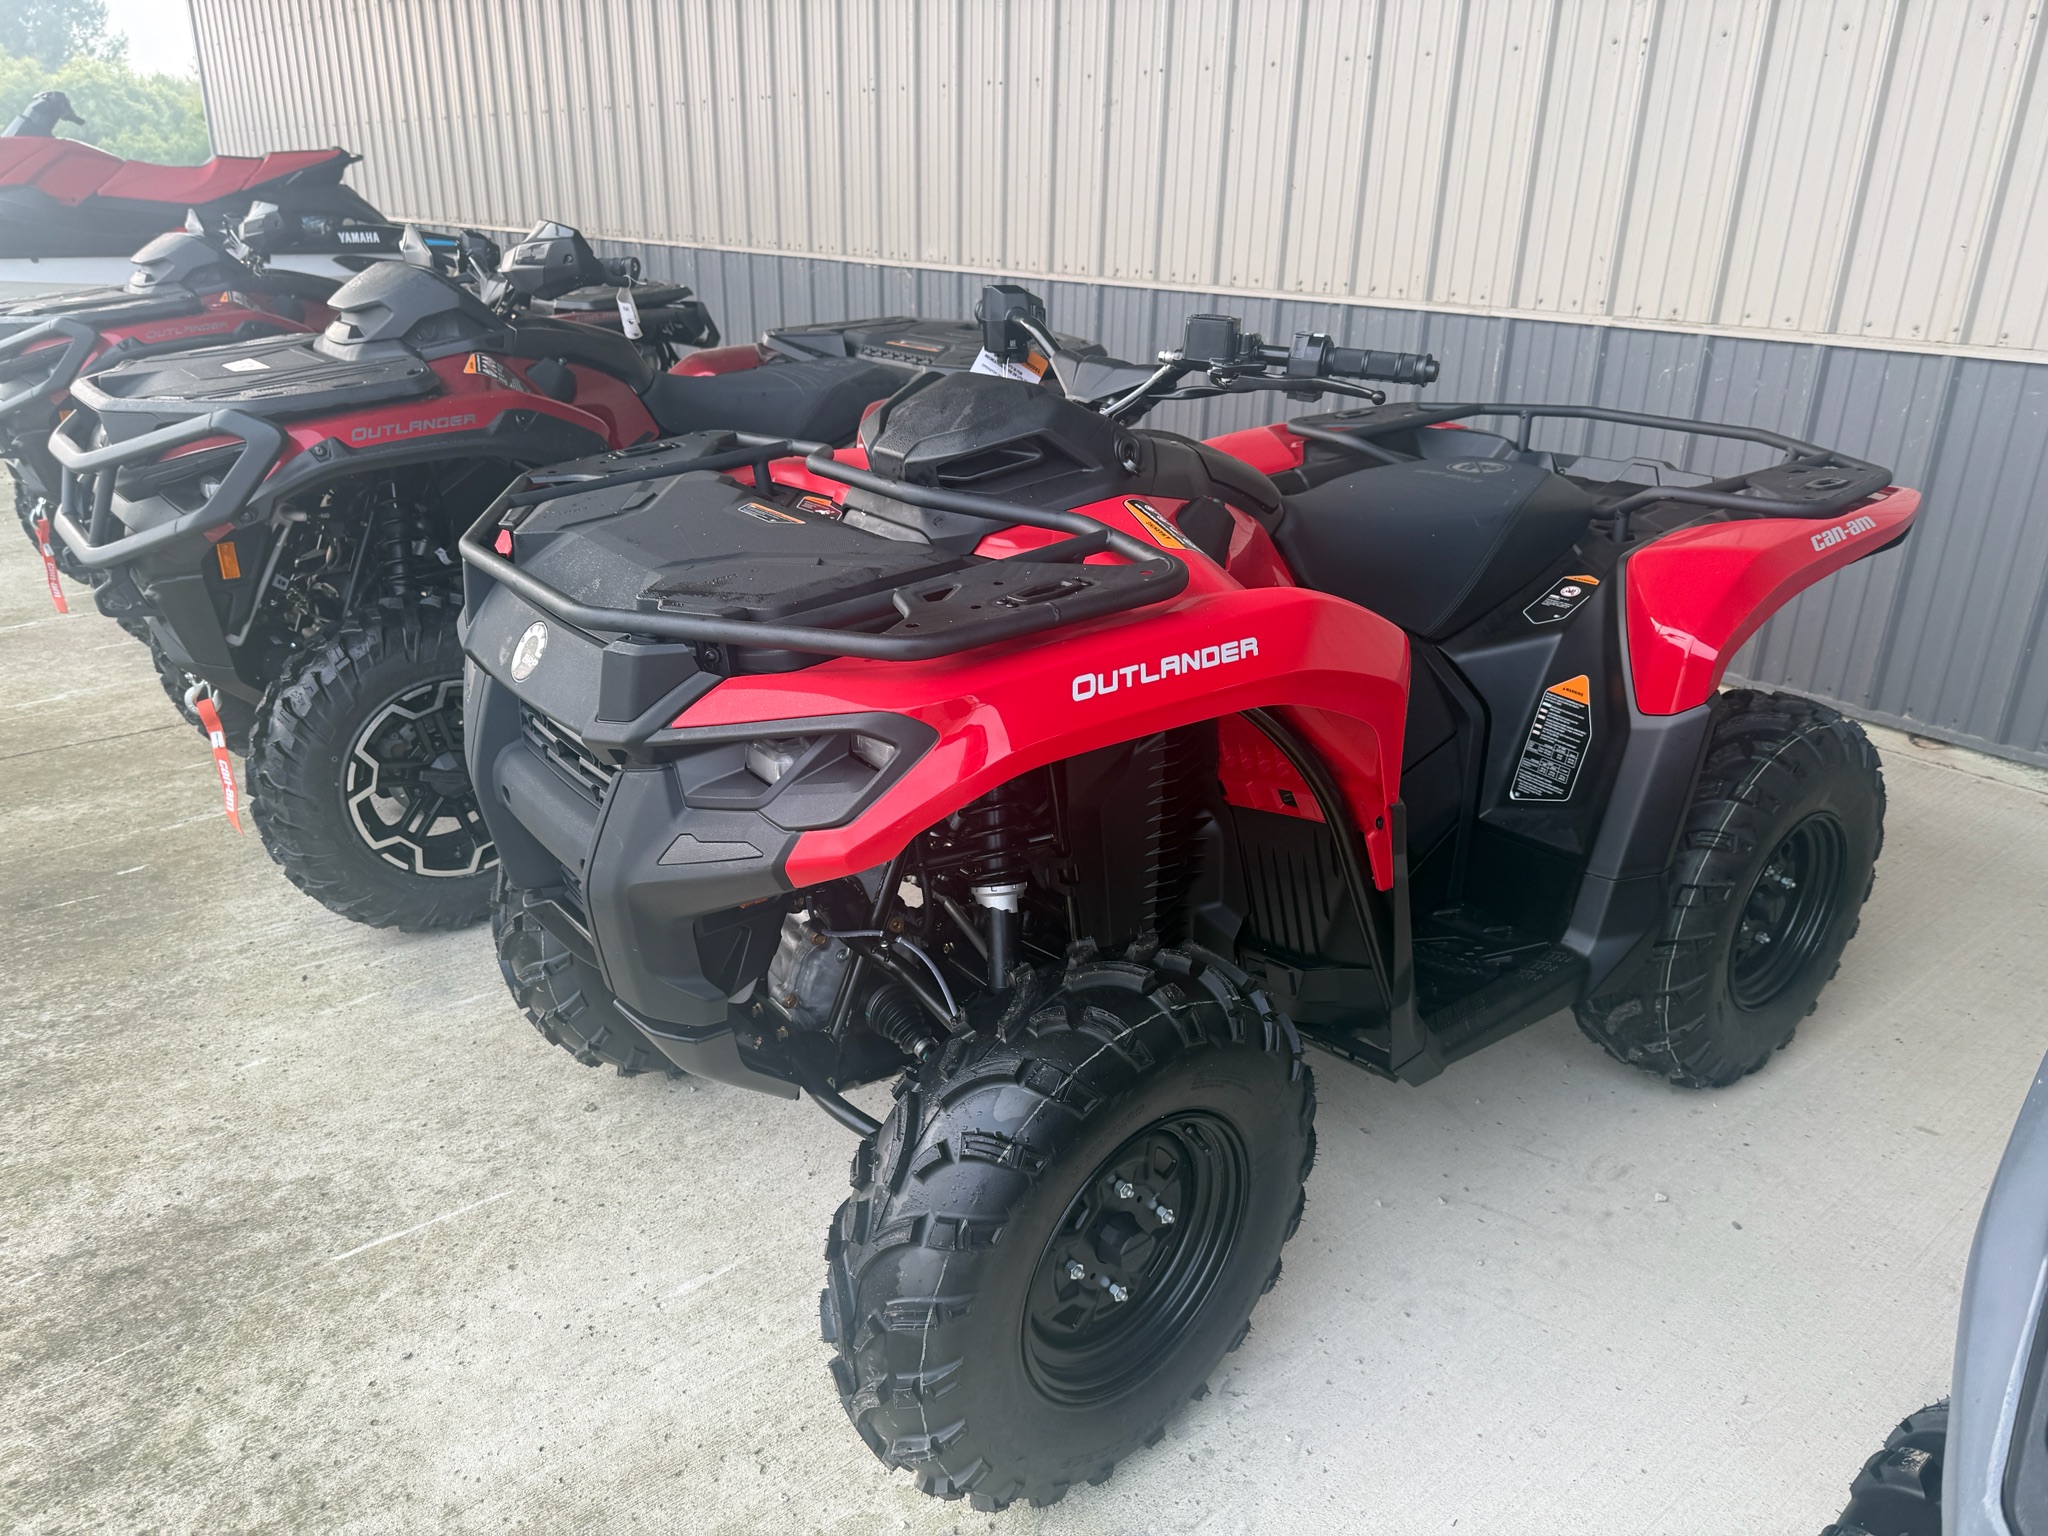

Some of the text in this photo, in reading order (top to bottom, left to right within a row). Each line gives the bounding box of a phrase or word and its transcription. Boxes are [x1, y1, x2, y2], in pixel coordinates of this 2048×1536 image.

[337, 231, 381, 244] YAMAHA
[146, 321, 229, 339] OUTLANDER
[351, 414, 477, 442] OUTLANDER
[1810, 515, 1877, 552] can-am
[1072, 636, 1259, 702] OUTLANDER
